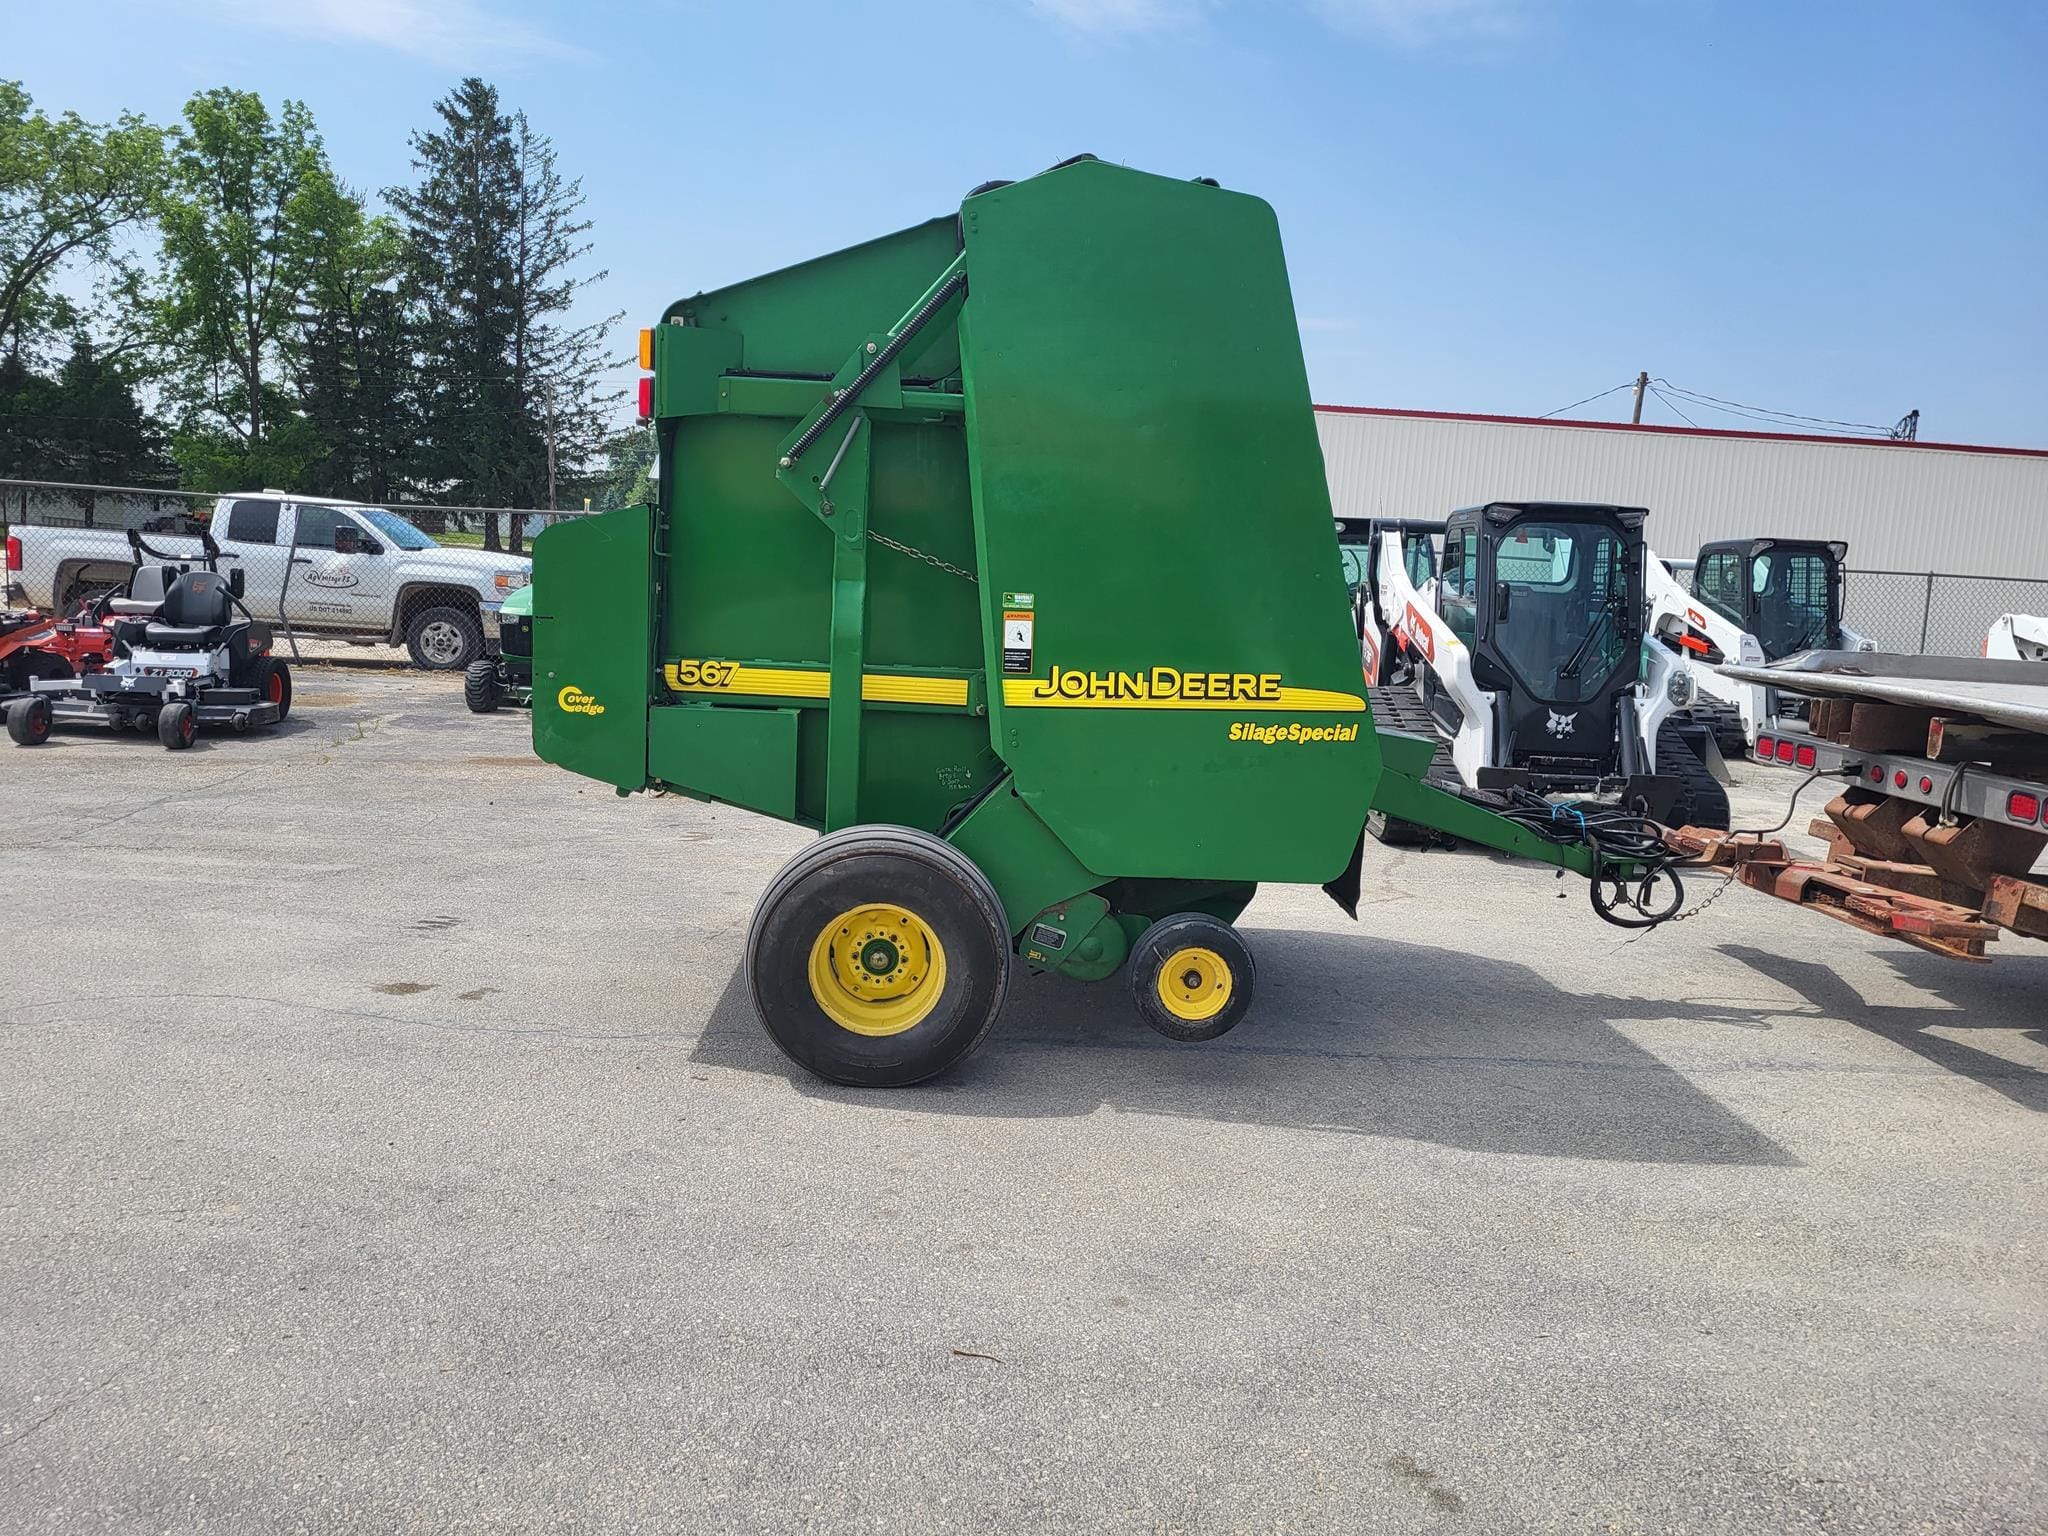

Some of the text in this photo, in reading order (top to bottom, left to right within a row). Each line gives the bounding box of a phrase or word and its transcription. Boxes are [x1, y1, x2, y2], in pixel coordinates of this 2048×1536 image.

[318, 605, 331, 613] DOT
[677, 659, 740, 687] 567
[1035, 664, 1283, 701] JOHN DEERE
[558, 686, 595, 712] Cover
[574, 704, 605, 716] edge
[1228, 721, 1359, 745] SilageSpecial
